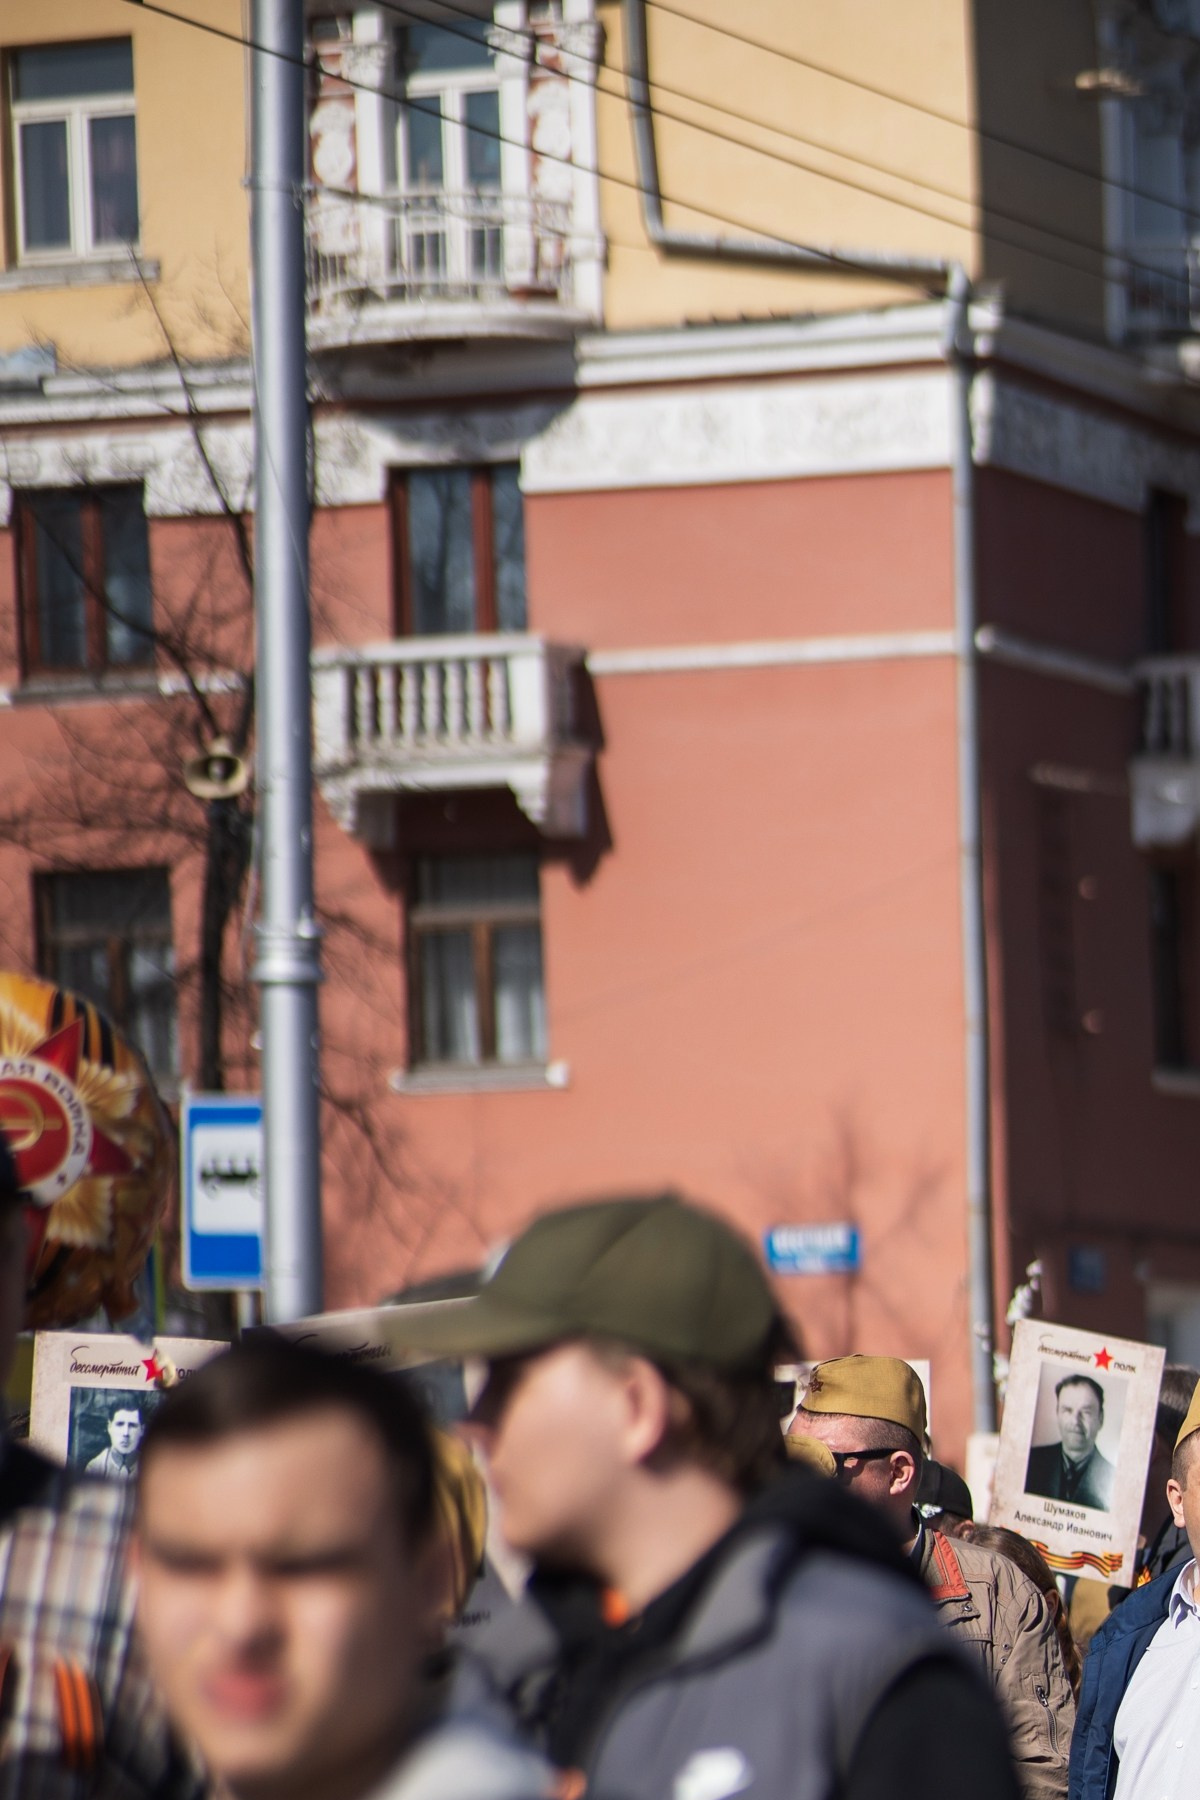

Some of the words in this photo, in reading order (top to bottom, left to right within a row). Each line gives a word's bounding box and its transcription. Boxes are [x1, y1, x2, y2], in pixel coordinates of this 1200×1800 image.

[69, 1345, 140, 1378] бессмертный
[1114, 1361, 1136, 1373] полк
[1044, 1501, 1086, 1520] Шумаков
[1014, 1510, 1064, 1532] Александр
[1066, 1522, 1112, 1541] Иванович
